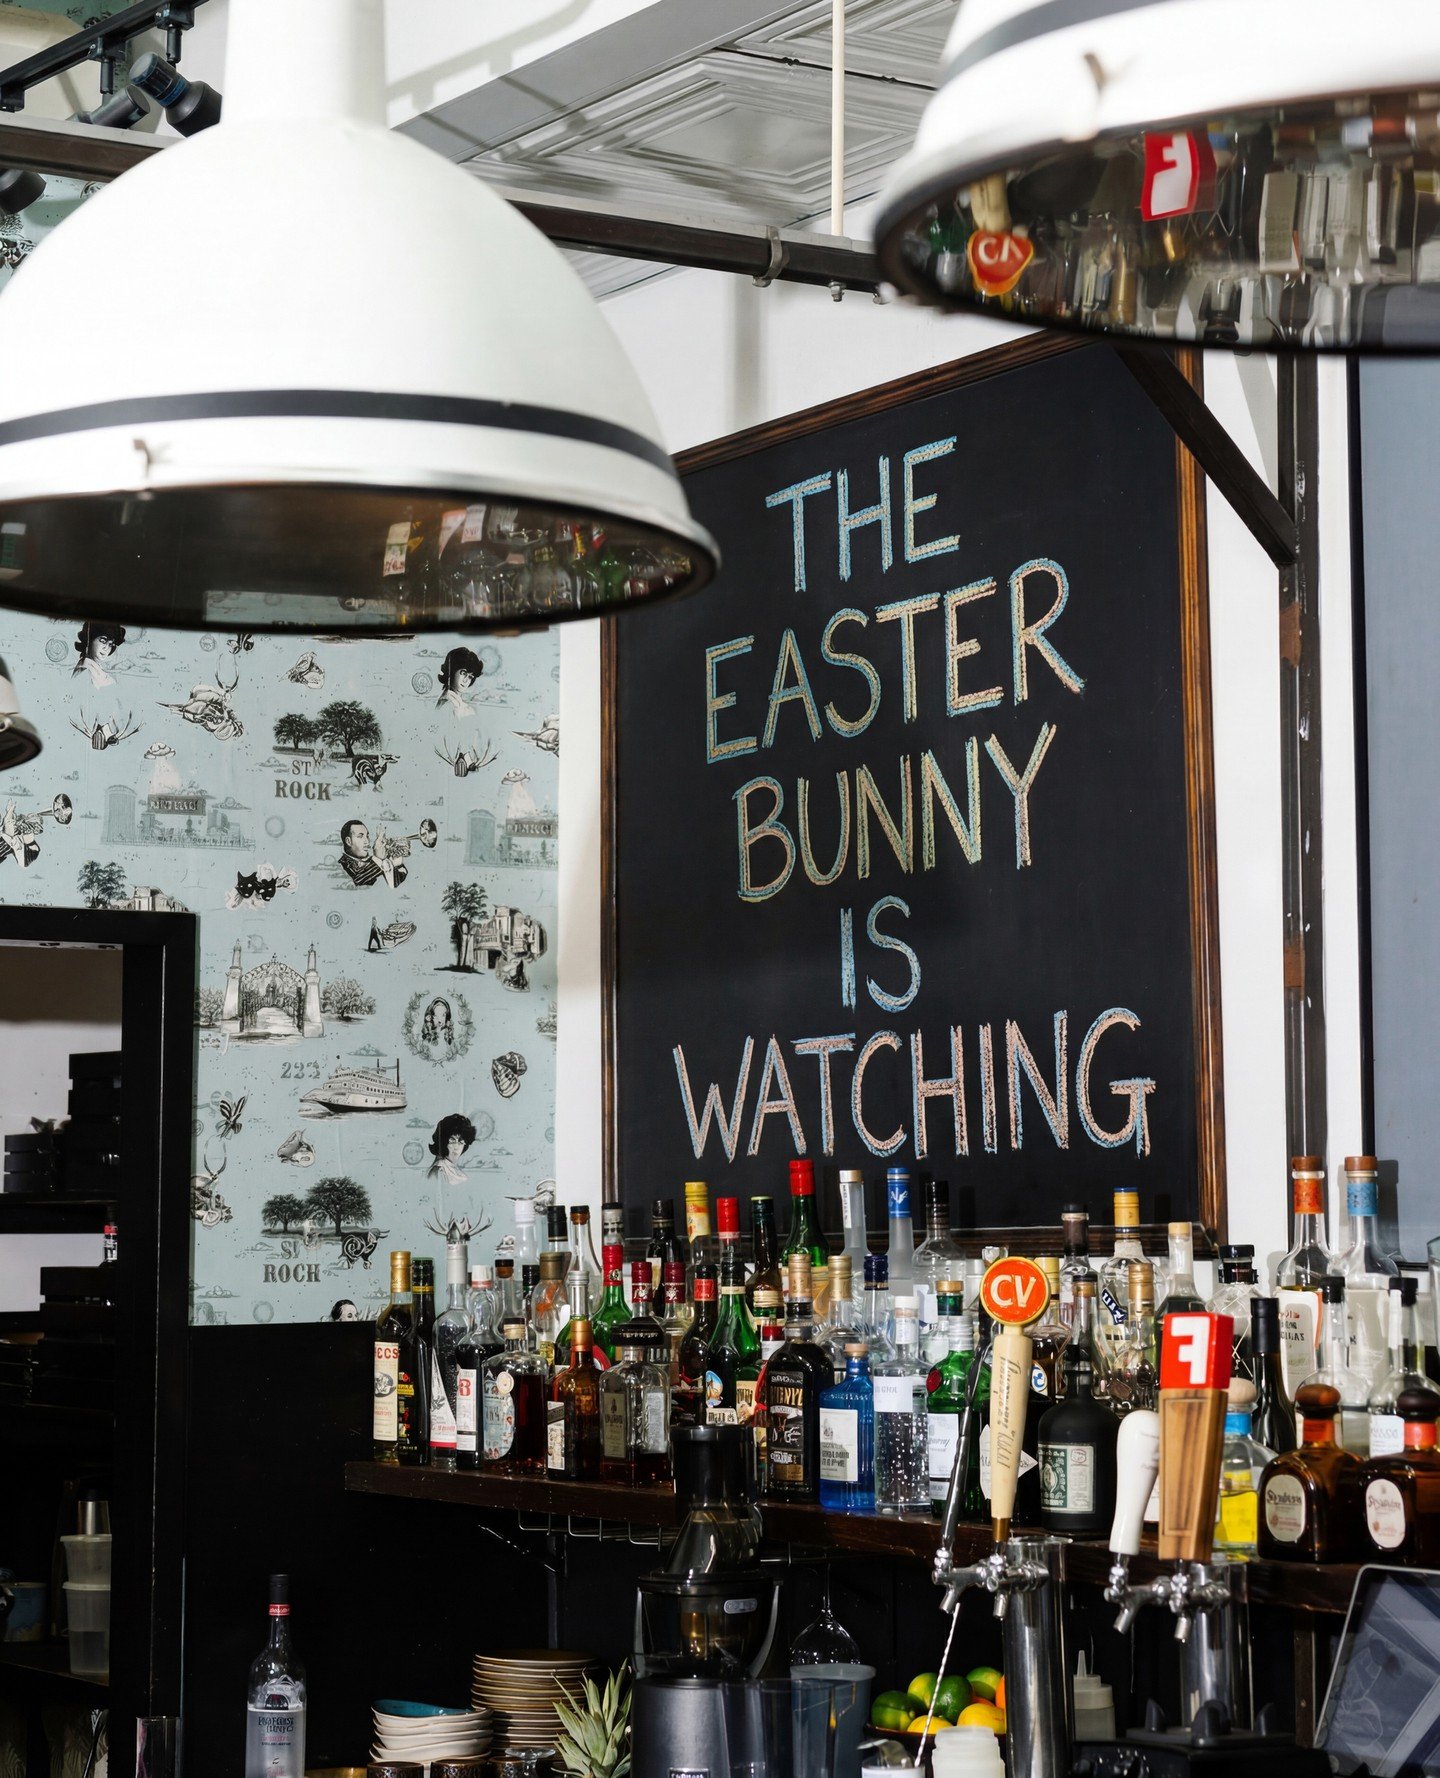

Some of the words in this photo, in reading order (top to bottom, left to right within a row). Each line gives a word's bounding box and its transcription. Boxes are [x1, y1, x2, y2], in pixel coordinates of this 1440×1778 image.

[766, 436, 960, 592] THE
[706, 558, 1085, 764] EASTER
[292, 760, 312, 777] ST
[733, 722, 1057, 902] BUNNY
[840, 896, 922, 1012] IS
[673, 1007, 1156, 1163] WATCHING
[990, 1274, 1037, 1308] CV
